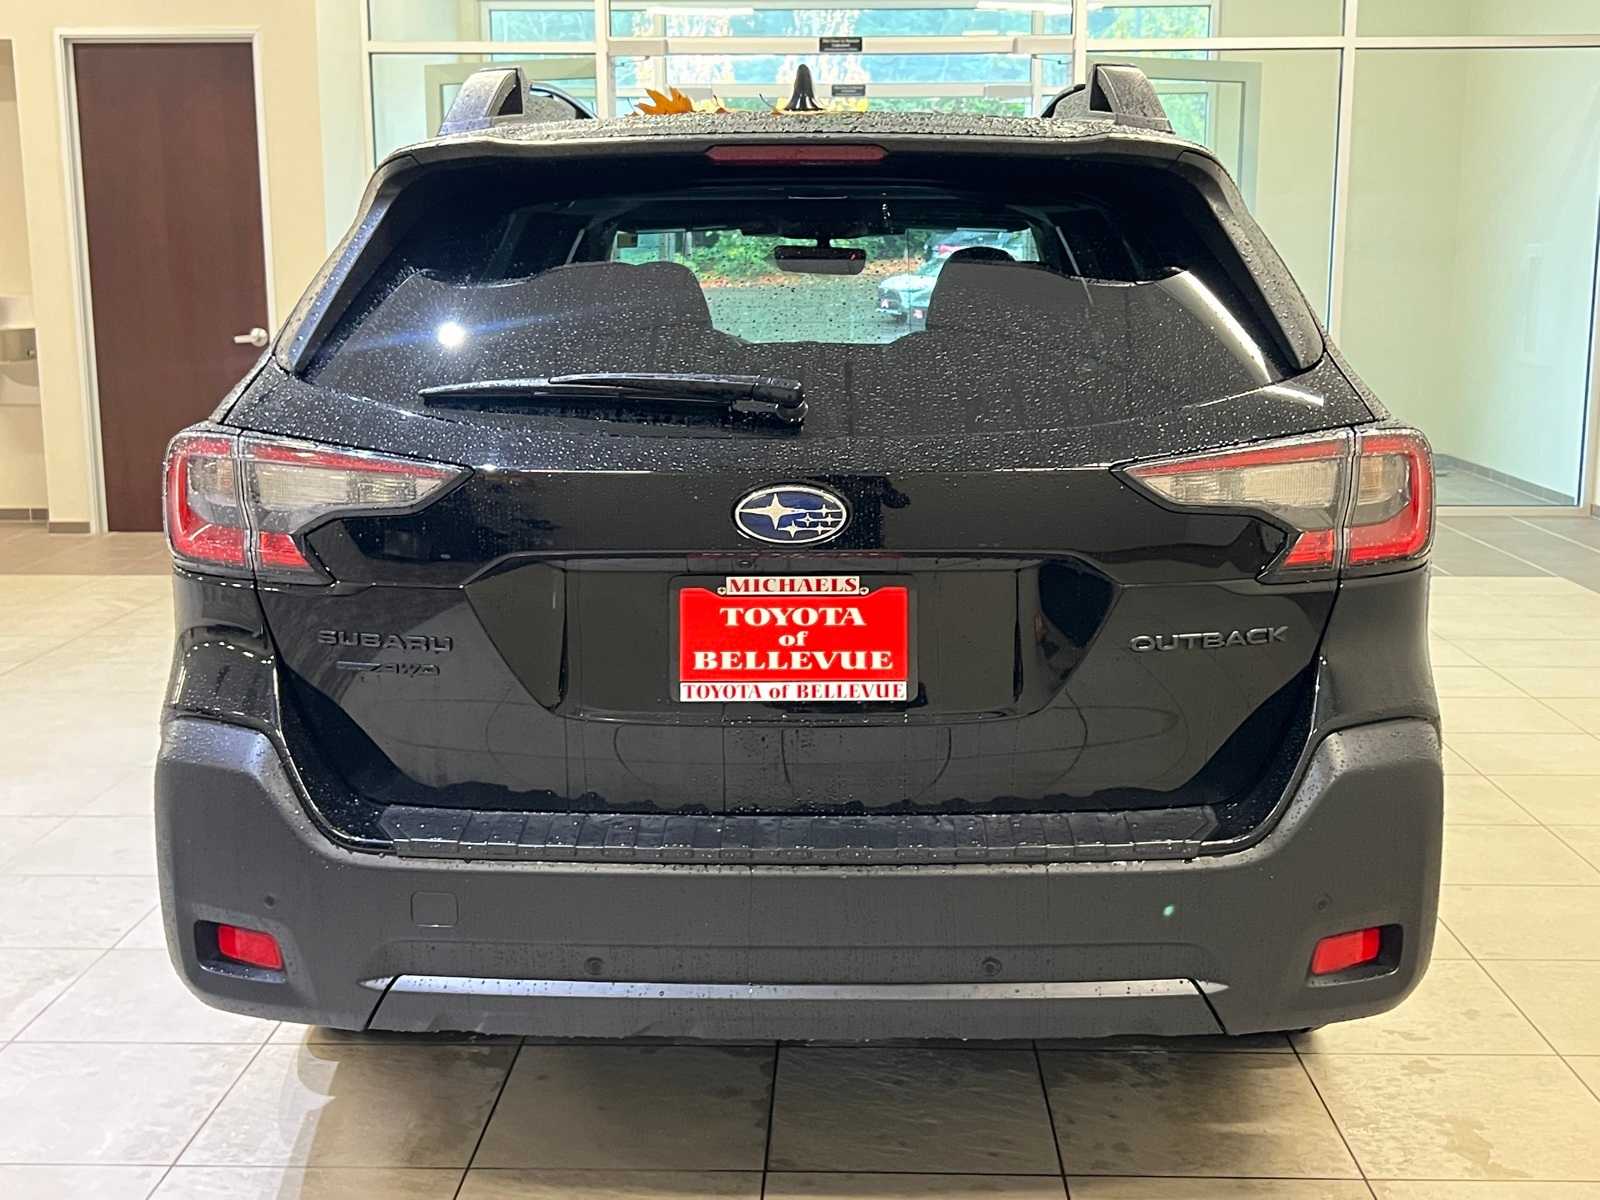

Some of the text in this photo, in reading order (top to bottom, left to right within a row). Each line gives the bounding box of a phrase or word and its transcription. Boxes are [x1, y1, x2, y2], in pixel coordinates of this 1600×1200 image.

[729, 577, 858, 593] MICHAELS
[719, 607, 867, 626] TOYOTA
[317, 629, 453, 653] SUBARU
[778, 630, 809, 647] of
[1129, 625, 1289, 652] OUTBACK
[692, 650, 894, 671] BELLEVUE
[682, 683, 905, 700] TOYOTA of BELLEVUE
